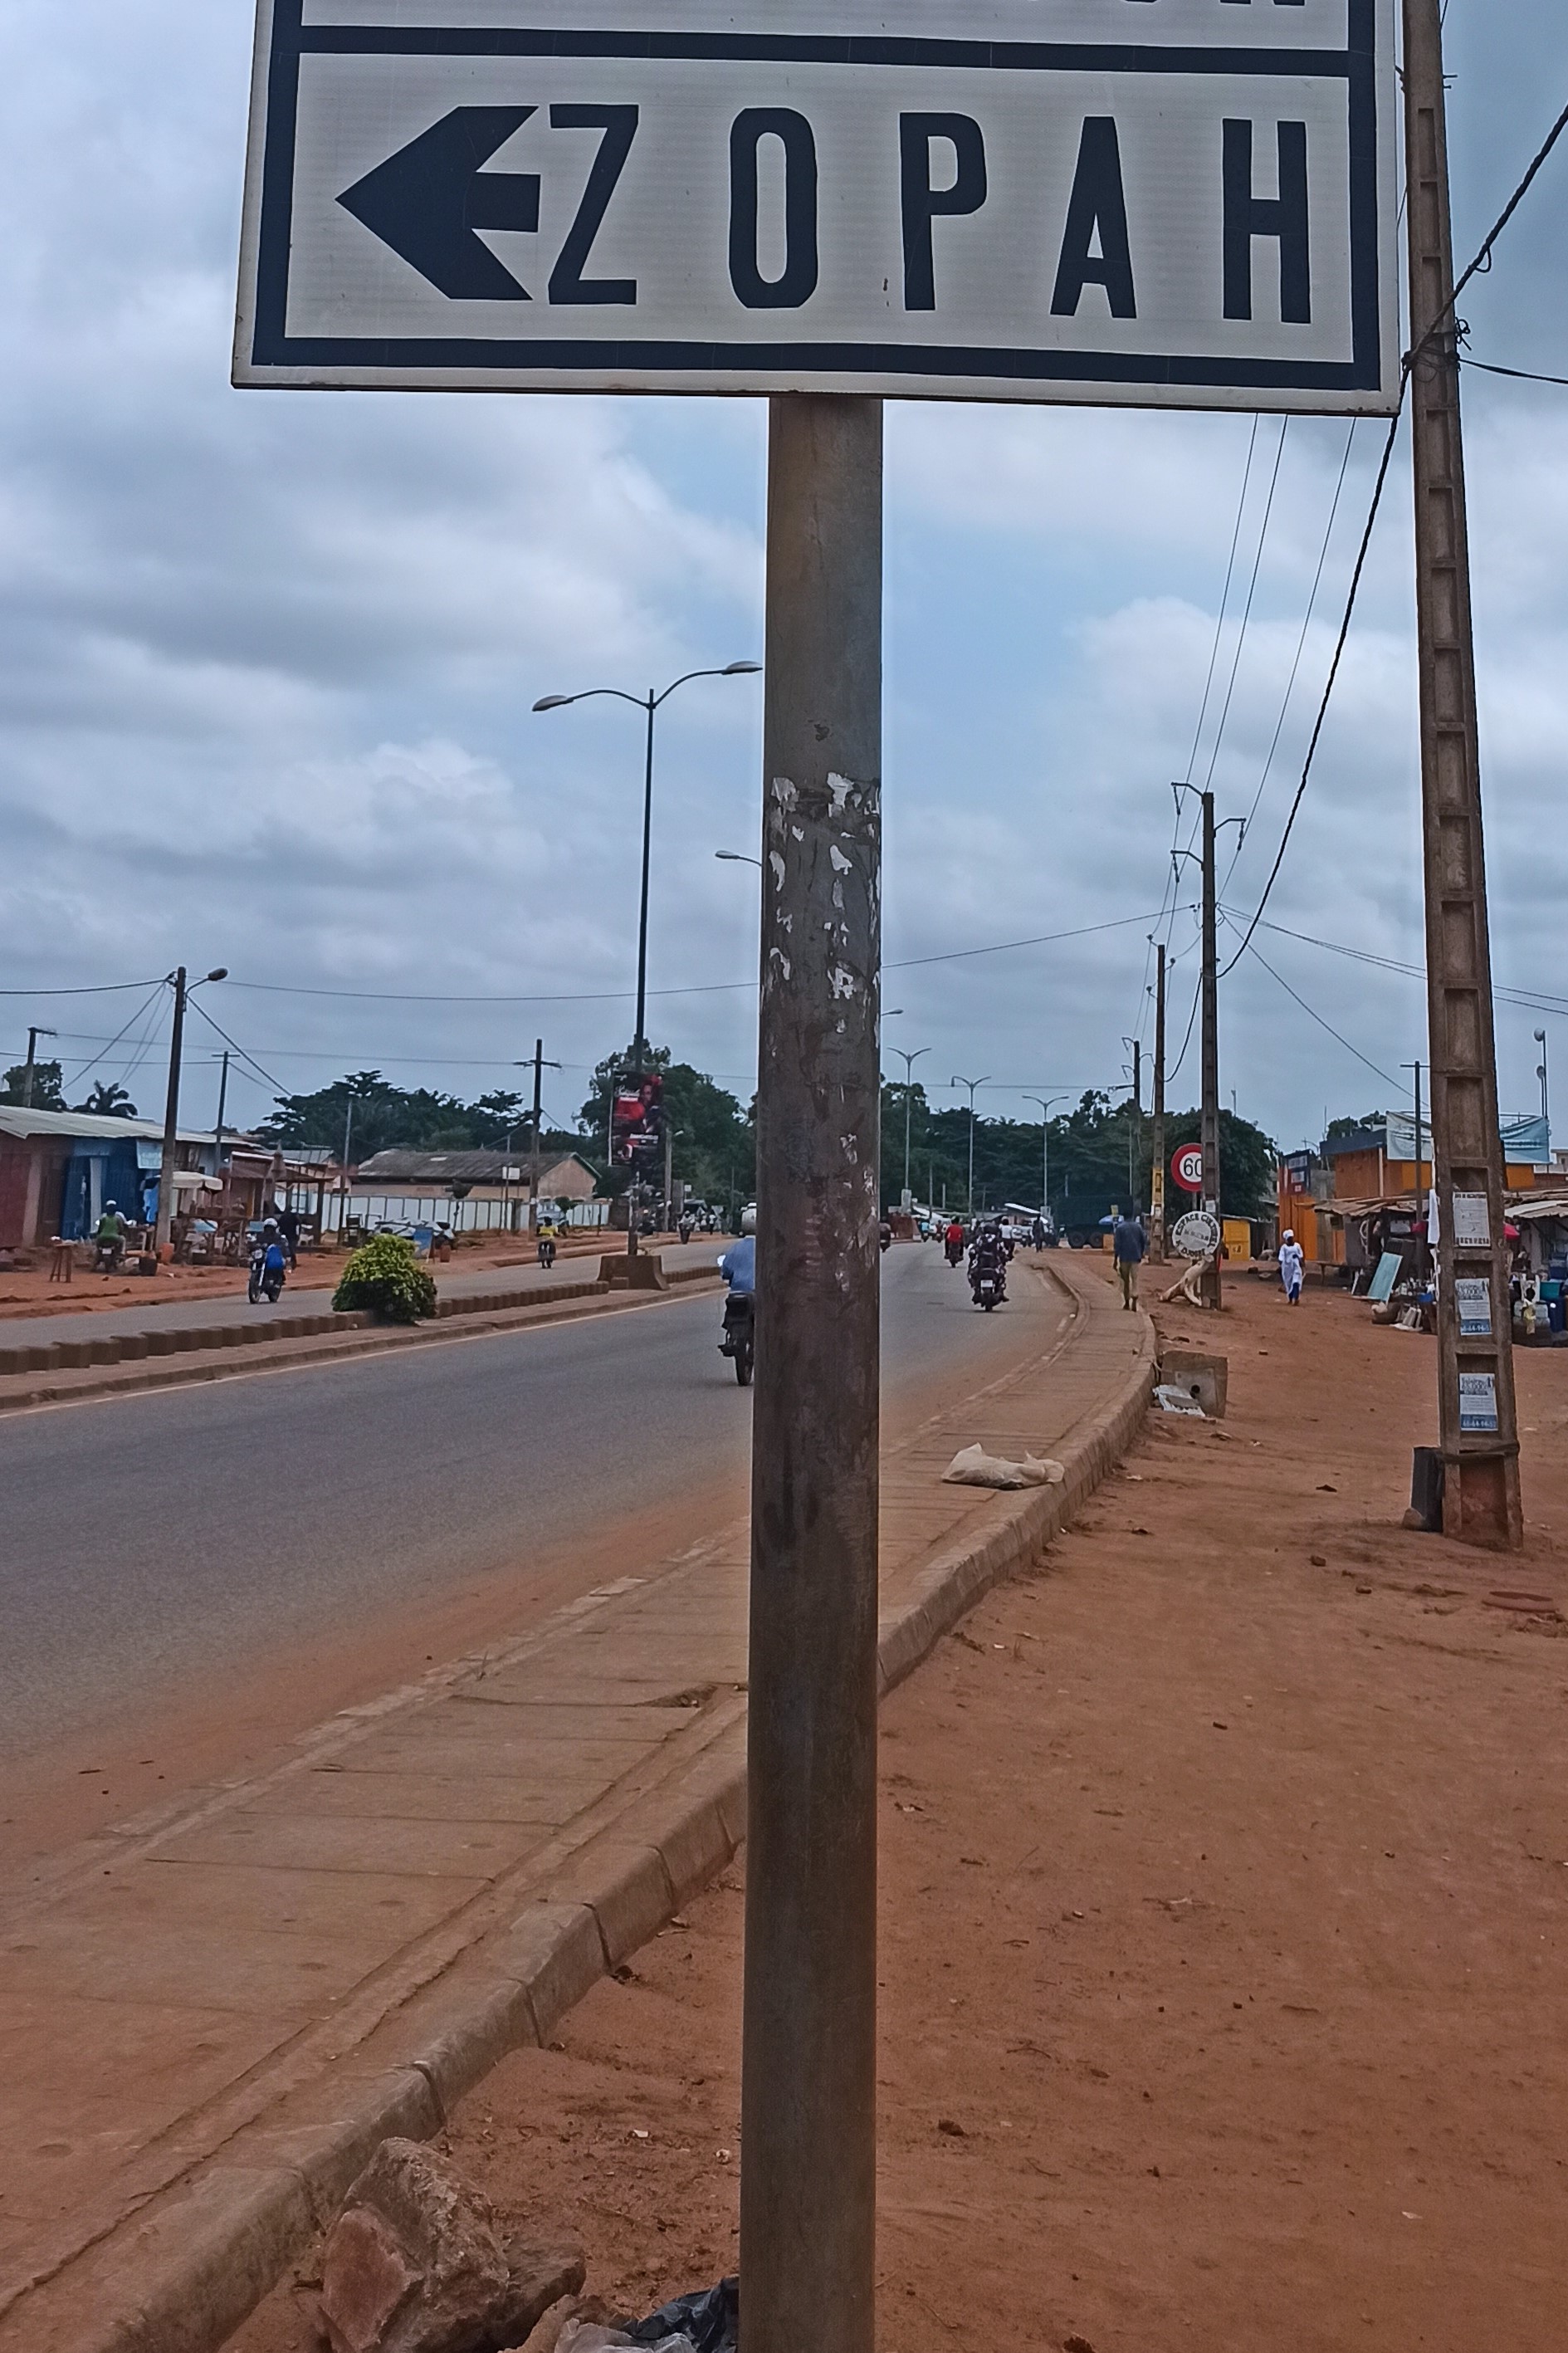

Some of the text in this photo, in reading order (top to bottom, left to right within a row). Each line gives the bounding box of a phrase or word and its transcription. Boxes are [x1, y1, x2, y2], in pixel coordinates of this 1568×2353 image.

[547, 103, 1312, 325] ZOPAH
[1184, 1157, 1202, 1176] 60
[1175, 1213, 1199, 1235] ESPACE
